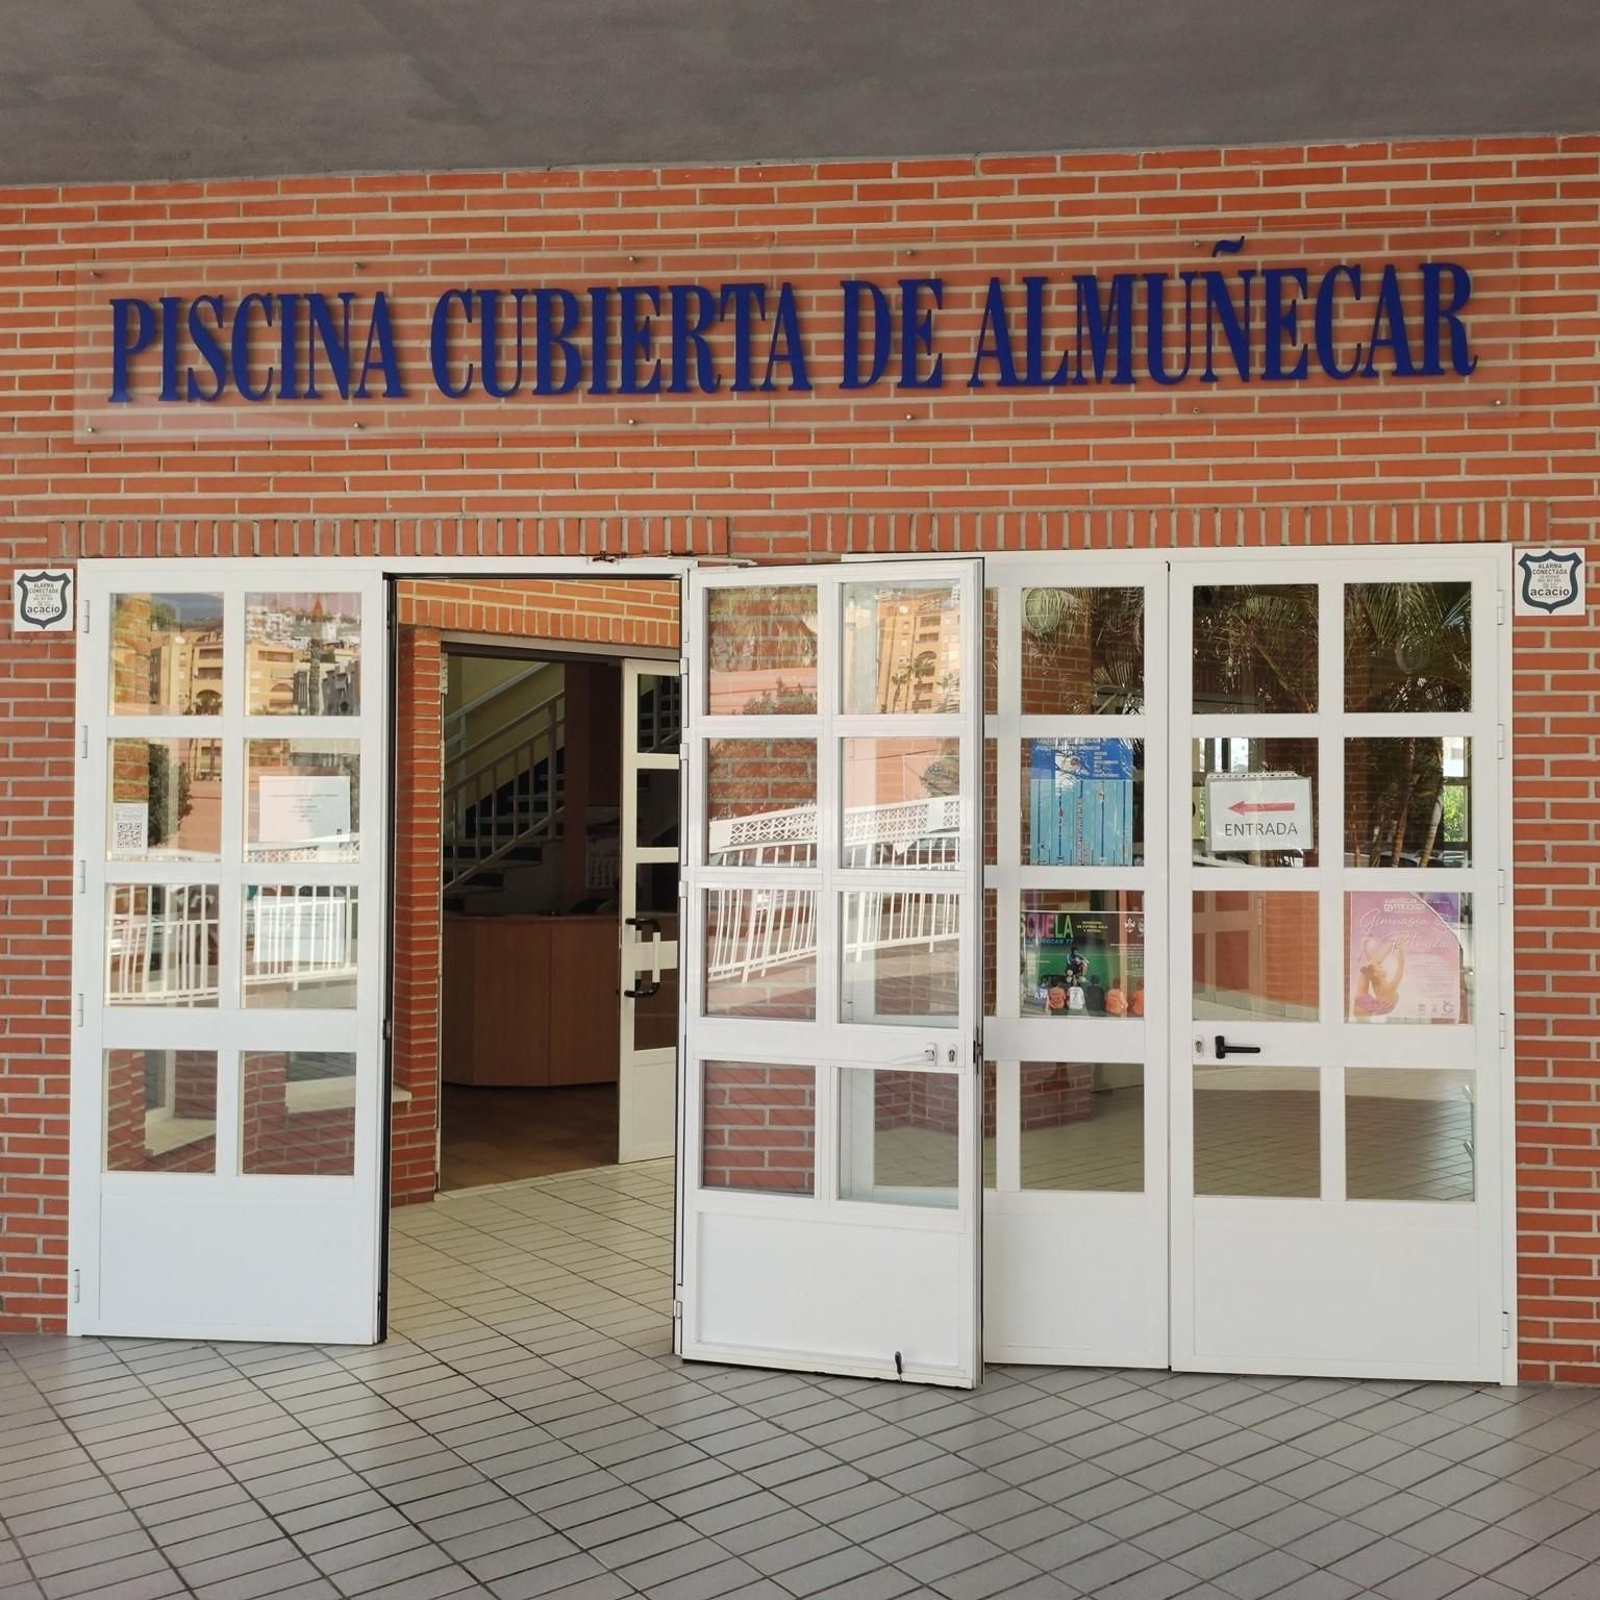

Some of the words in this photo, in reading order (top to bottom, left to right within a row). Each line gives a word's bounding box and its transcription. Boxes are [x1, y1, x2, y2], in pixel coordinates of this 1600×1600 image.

[109, 291, 405, 402] PISCINA
[430, 282, 813, 398] CUBIERTA
[839, 278, 943, 389] DE
[967, 236, 1478, 388] ALMUÑECAR
[1530, 586, 1570, 596] acacio
[27, 605, 60, 613] acacio
[1225, 822, 1298, 836] ENTRADA
